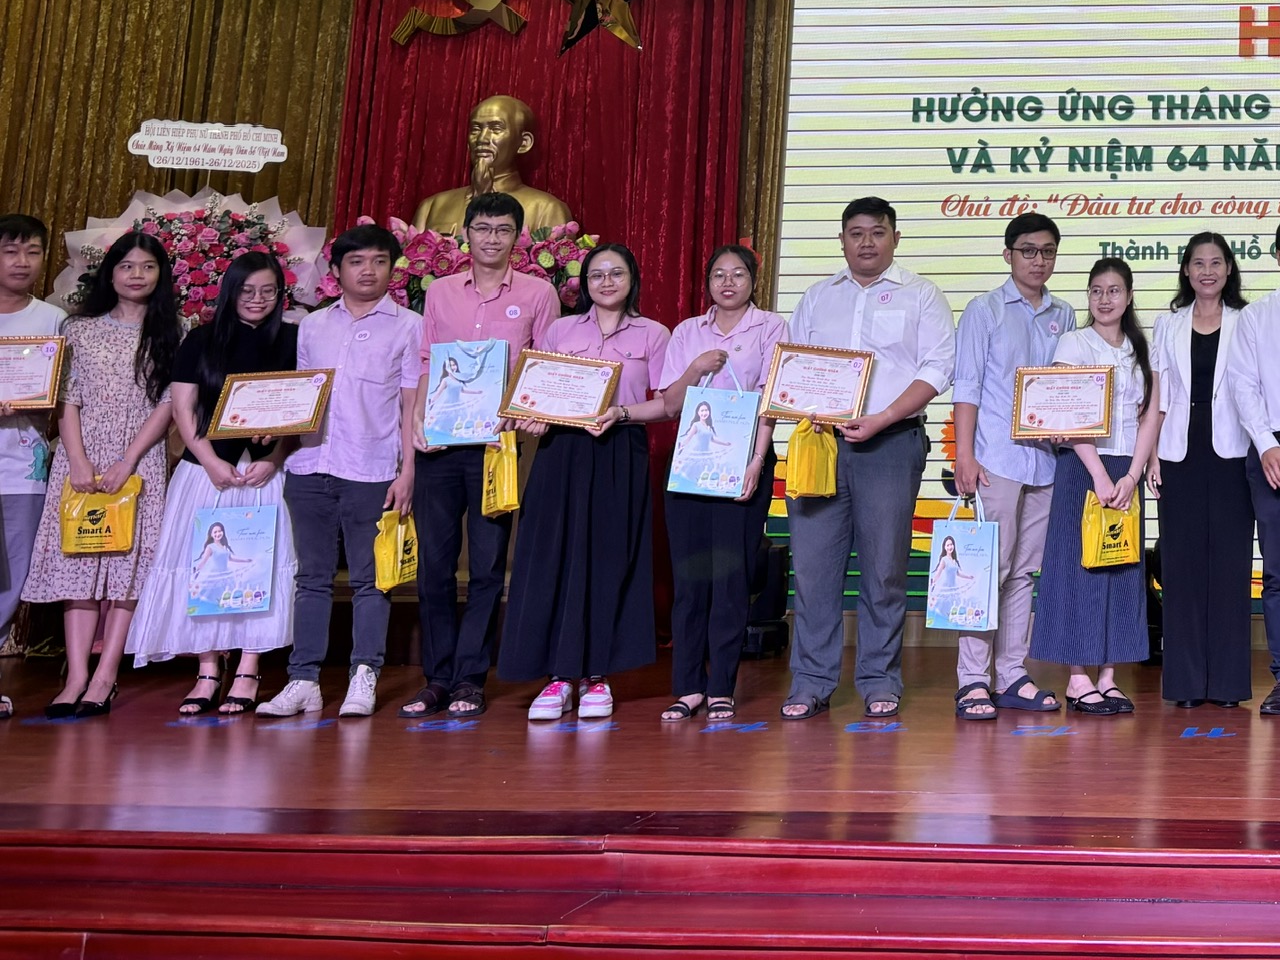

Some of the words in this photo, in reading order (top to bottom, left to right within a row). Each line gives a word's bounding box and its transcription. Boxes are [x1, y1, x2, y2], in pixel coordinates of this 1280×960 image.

[911, 87, 1043, 123] HƯỞNG
[1058, 88, 1134, 123] ỨNG
[1147, 86, 1271, 122] THÁNG
[946, 139, 995, 174] VÀ
[1010, 136, 1054, 174] KỶ
[1068, 138, 1154, 179] NIỆM
[1166, 144, 1209, 172] 64
[941, 193, 993, 217] Chủ
[999, 193, 1038, 217] đề:
[1127, 195, 1156, 215] tư
[1160, 193, 1205, 216] cho
[1210, 193, 1272, 219] công
[1099, 240, 1169, 260] Thành
[77, 526, 102, 535] Smart
[105, 525, 111, 533] A
